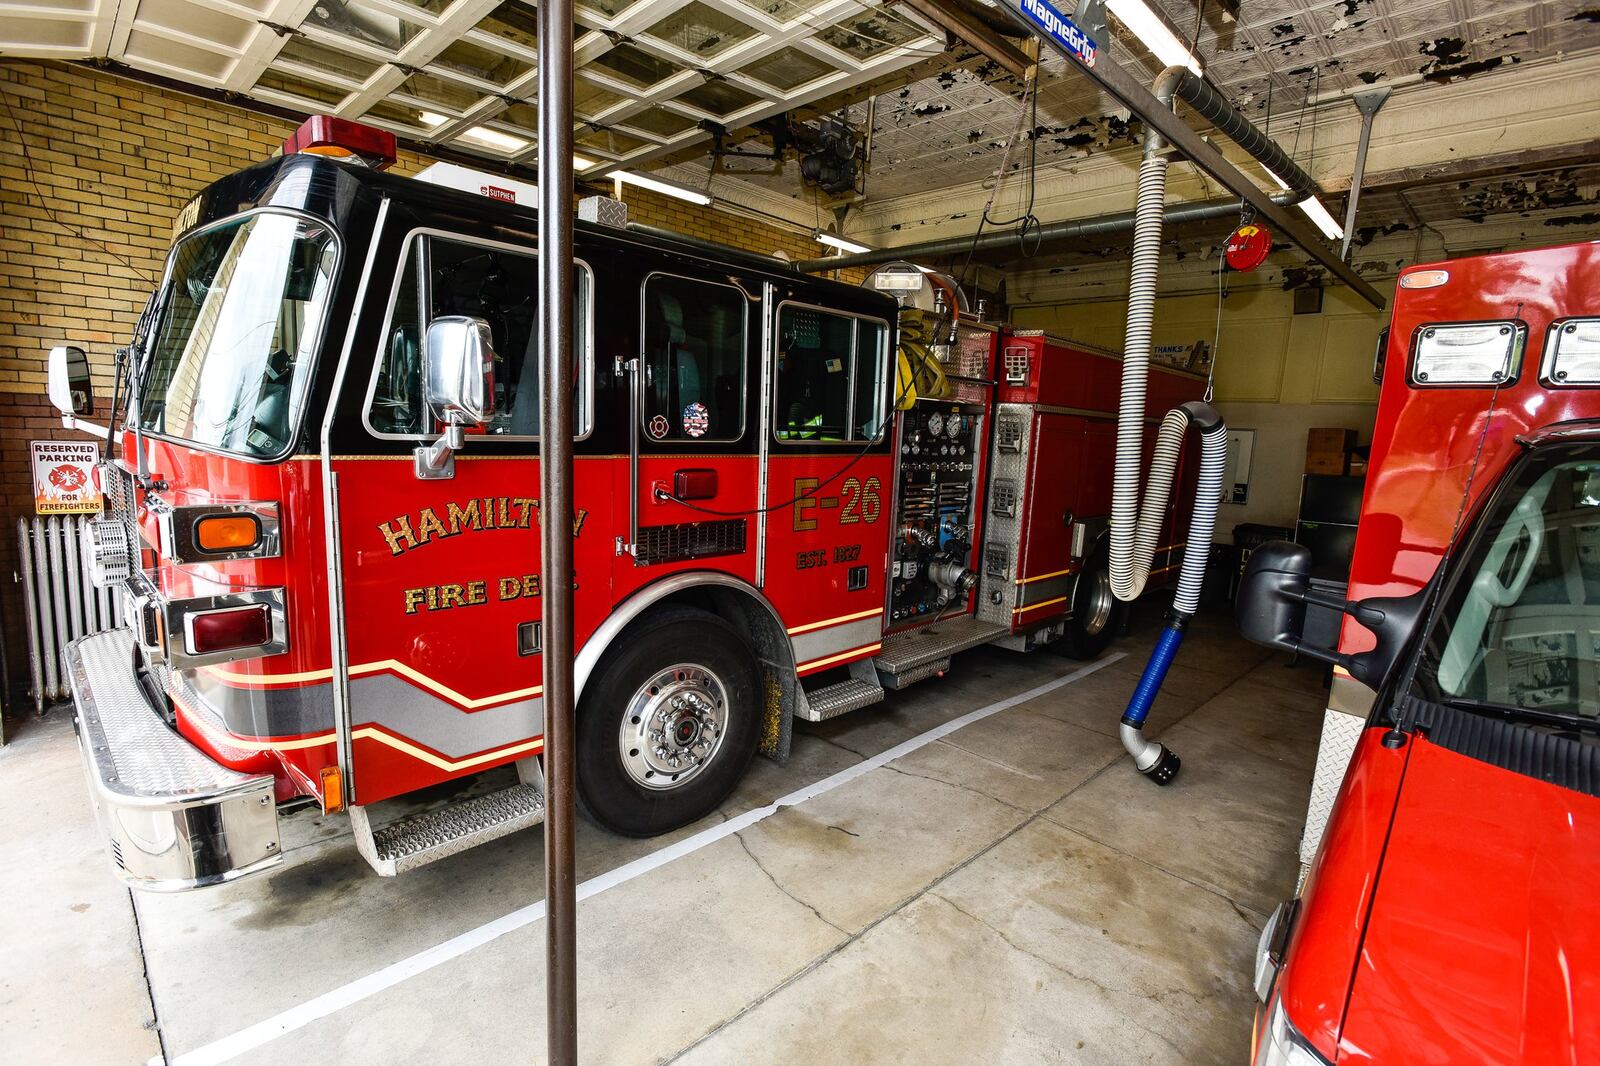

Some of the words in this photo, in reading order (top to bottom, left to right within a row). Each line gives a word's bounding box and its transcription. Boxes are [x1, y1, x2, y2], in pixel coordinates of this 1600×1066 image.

[490, 189, 515, 201] SUTPHEN
[1154, 345, 1184, 353] THANKS
[35, 445, 94, 453] RESERVED
[40, 502, 100, 511] FIREFIGHTERS
[793, 477, 881, 532] E-26
[377, 497, 588, 557] HAMILT
[797, 549, 827, 570] EST.
[833, 545, 862, 563] 1827
[404, 580, 488, 614] FIRE
[499, 571, 579, 601] DE.
